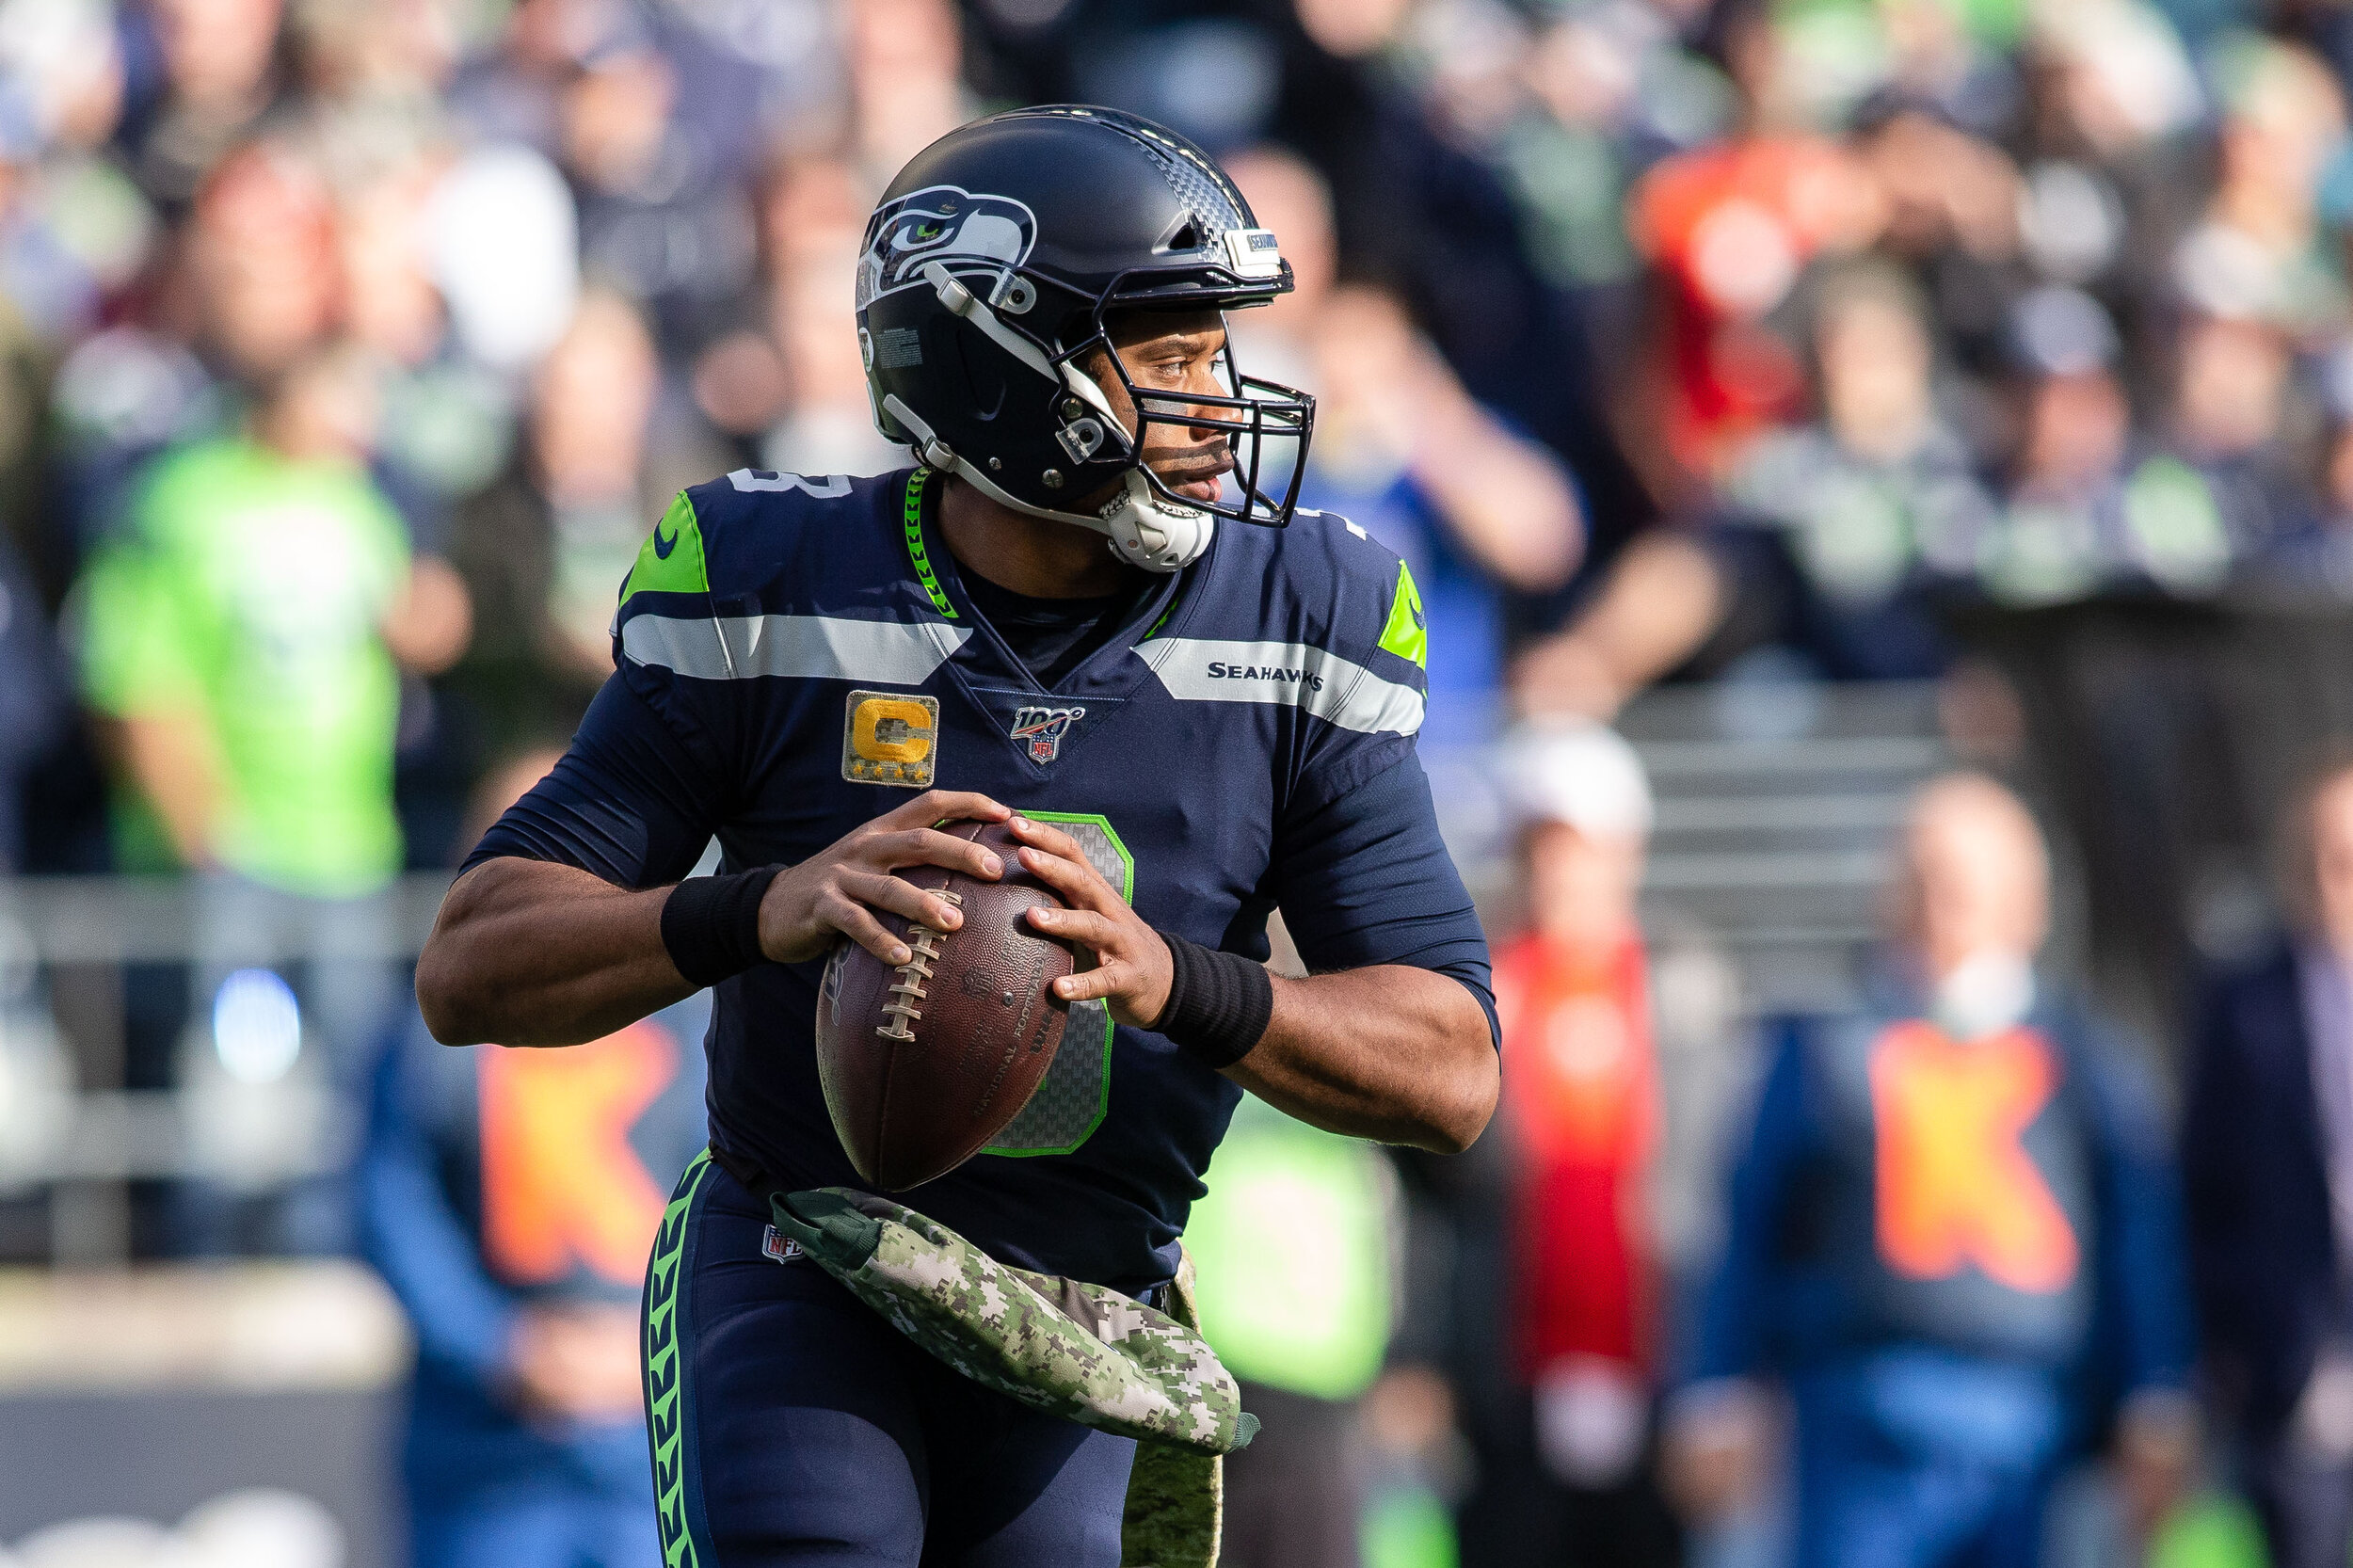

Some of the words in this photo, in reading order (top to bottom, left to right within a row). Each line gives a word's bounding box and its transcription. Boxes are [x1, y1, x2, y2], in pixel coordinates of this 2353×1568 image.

[1208, 662, 1324, 692] SEAHAWKS
[853, 698, 931, 763] C
[1033, 742, 1054, 757] NFL
[1014, 956, 1046, 1040] FOOTBALL
[1868, 1017, 2083, 1295] K
[769, 1237, 803, 1256] NFL
